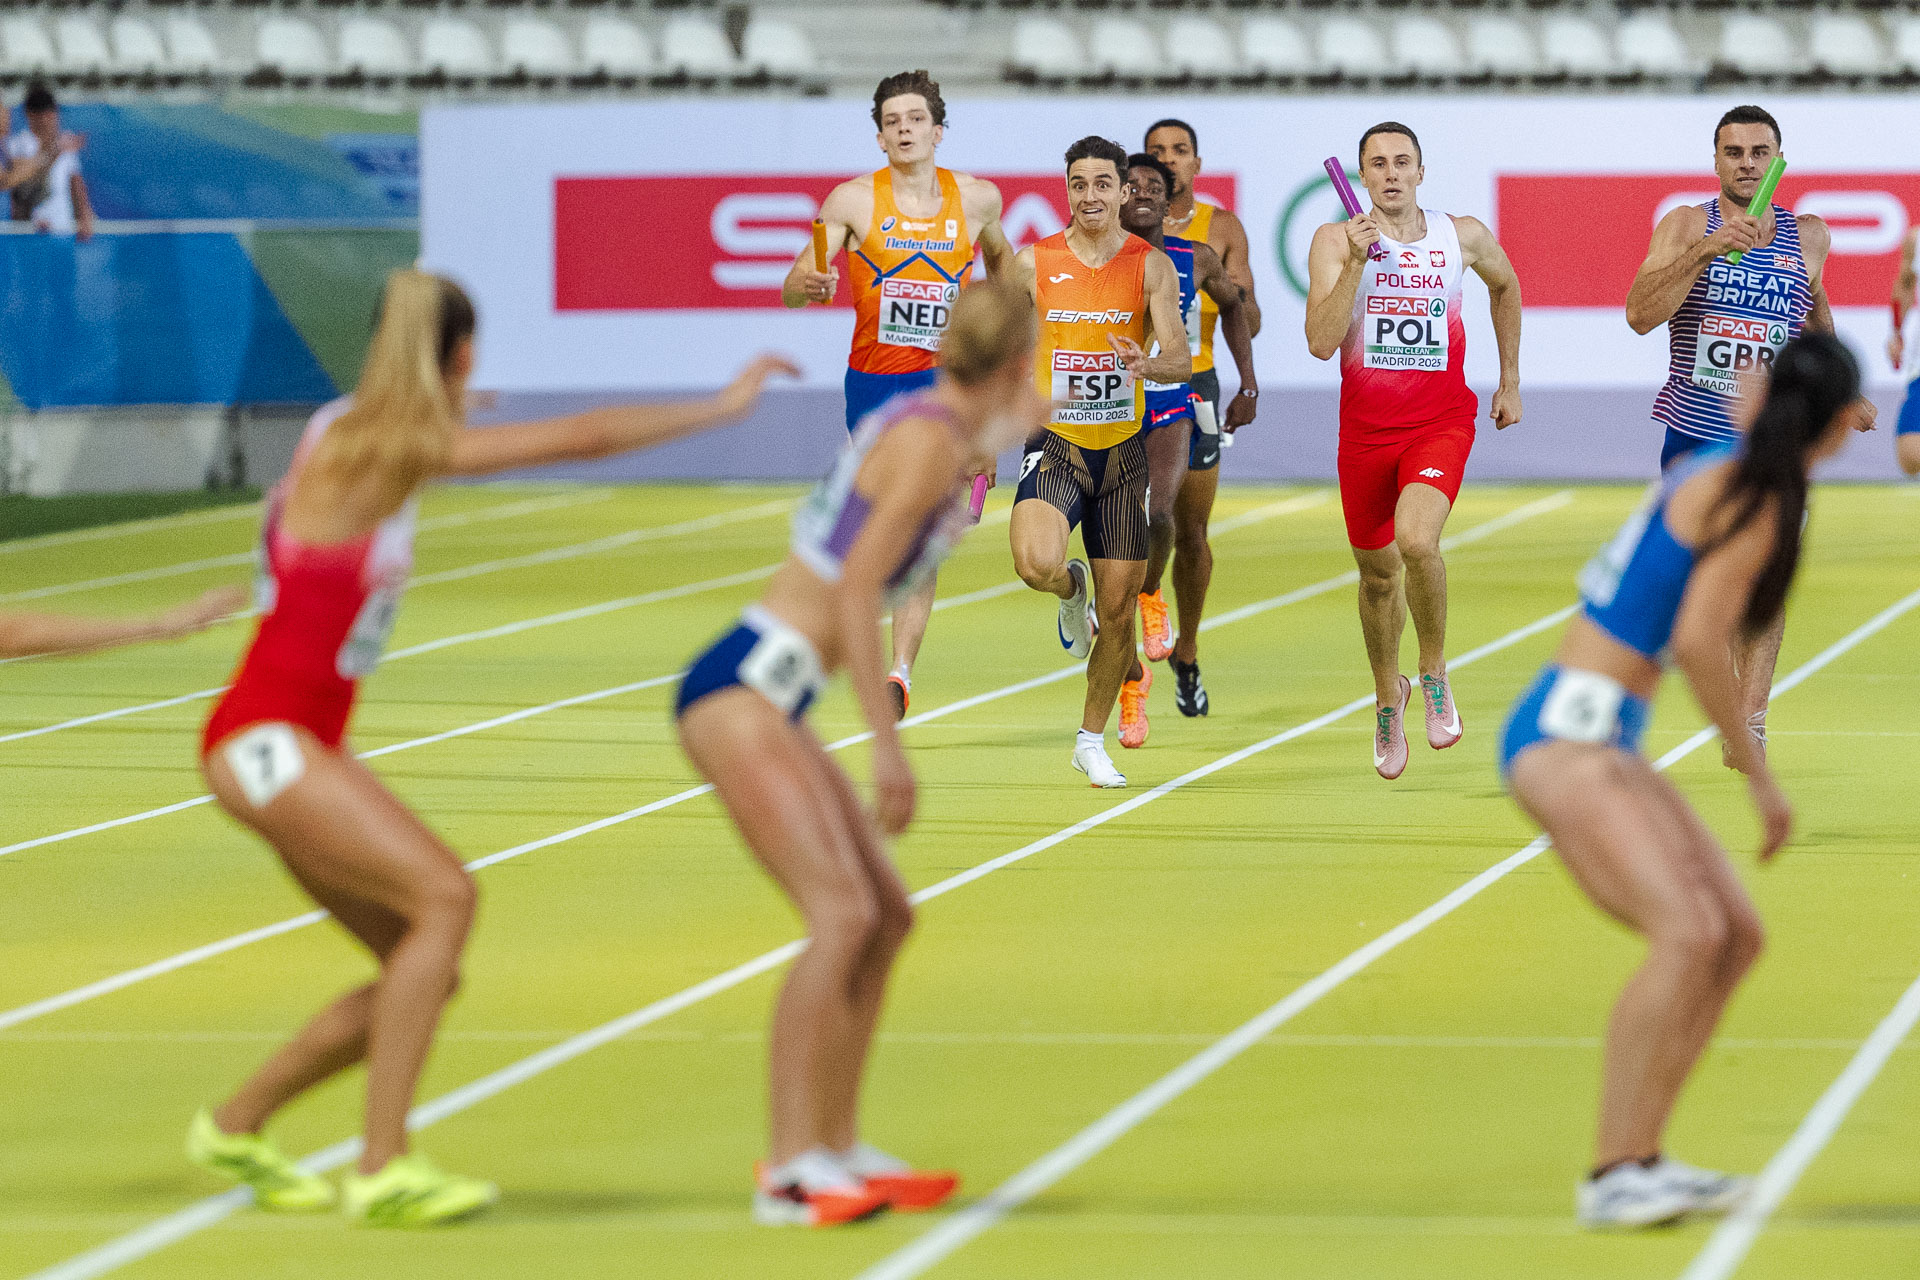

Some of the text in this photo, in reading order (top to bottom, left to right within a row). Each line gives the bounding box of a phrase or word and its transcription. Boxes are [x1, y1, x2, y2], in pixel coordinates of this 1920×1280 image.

[885, 237, 955, 251] Nederland
[1376, 272, 1444, 289] POLSKA
[1709, 266, 1795, 295] GREAT
[884, 282, 941, 300] SPAR
[1705, 284, 1791, 315] BRITAIN
[1368, 298, 1427, 314] SPAR
[890, 302, 950, 328] NED
[1046, 309, 1134, 324] ESPAÑA
[1376, 318, 1440, 346] POL
[1702, 318, 1766, 340] SPAR
[886, 333, 940, 348] MADRID 20
[1055, 354, 1114, 370] SPAR
[1372, 355, 1441, 368] MADRID 2025
[1707, 340, 1775, 374] GBR
[1716, 370, 1735, 380] RUN
[1068, 374, 1122, 401] ESP
[1058, 410, 1129, 421] MADRID 2025
